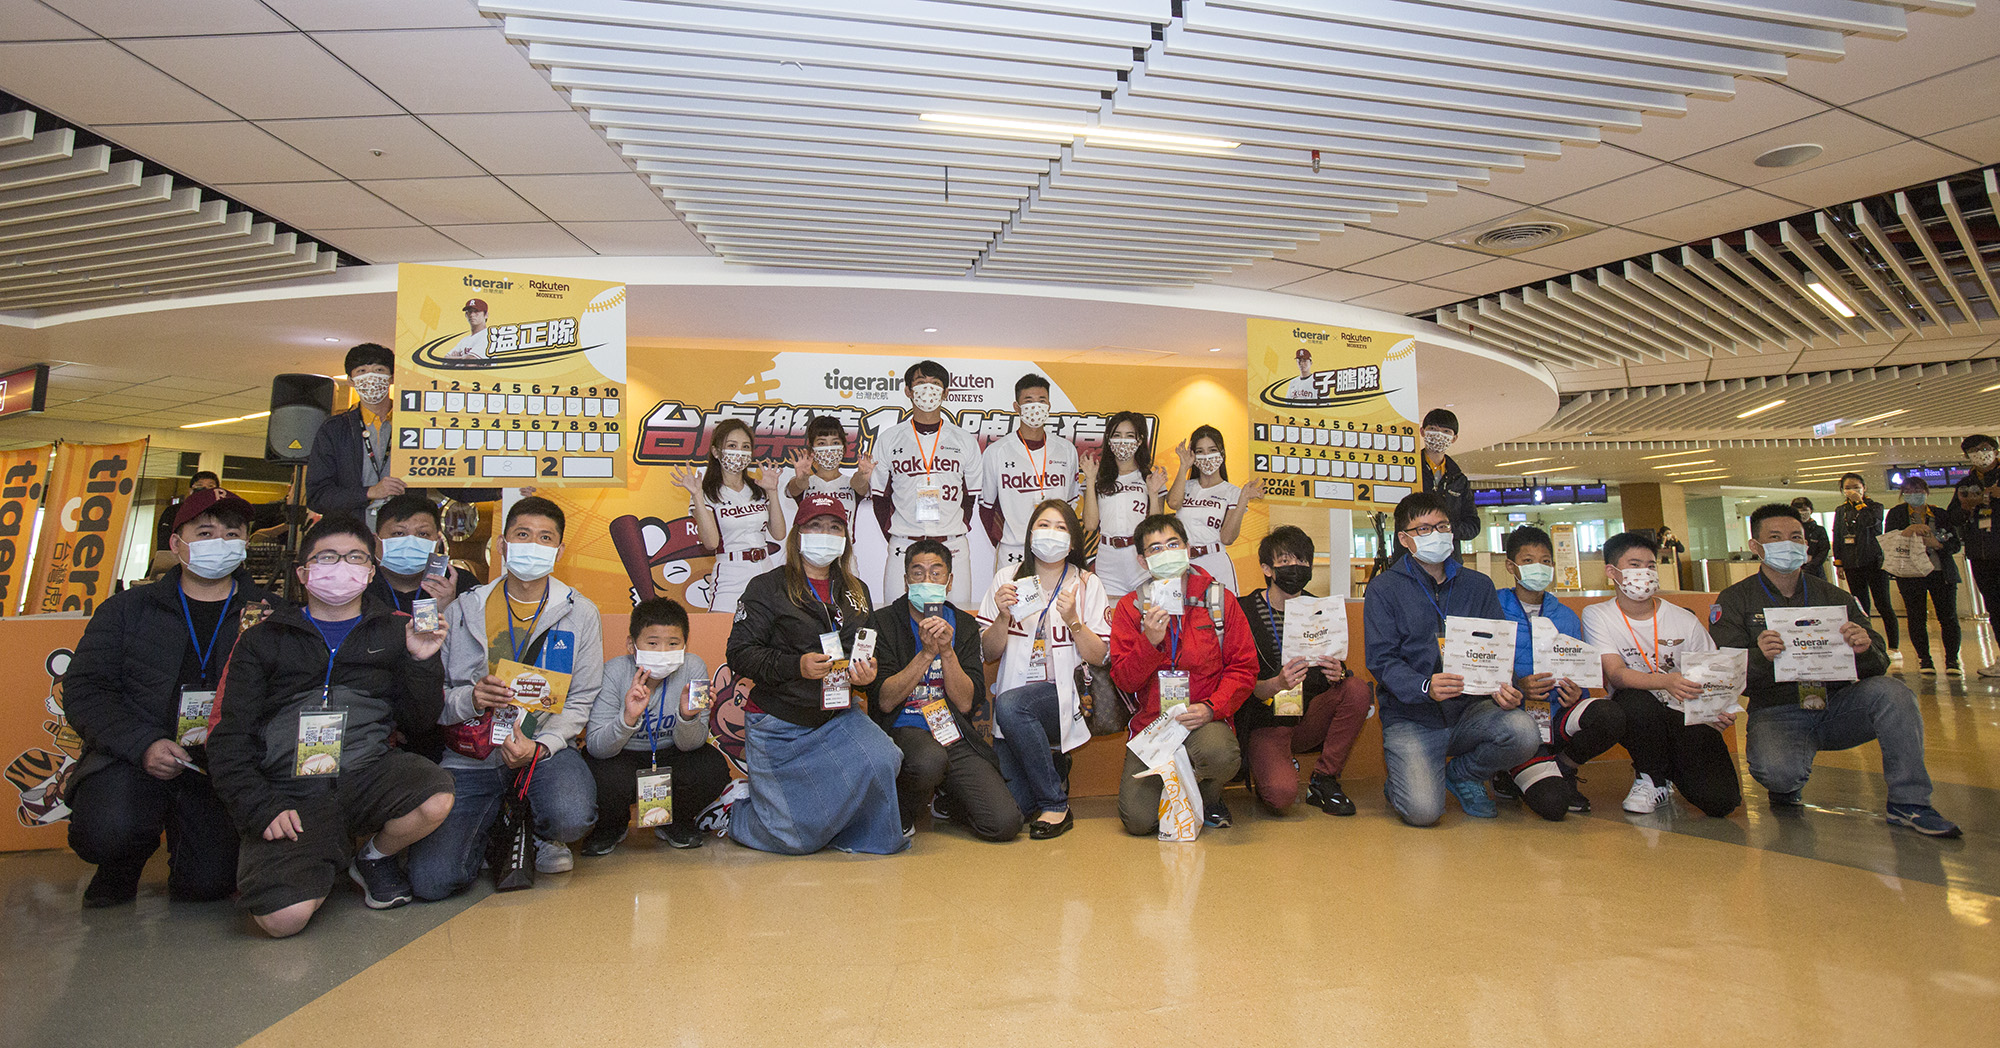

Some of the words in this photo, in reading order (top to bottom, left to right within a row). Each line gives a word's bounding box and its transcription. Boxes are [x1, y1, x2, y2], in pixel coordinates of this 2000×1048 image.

[463, 275, 514, 292] tigerair
[529, 280, 569, 292] Rakuten
[1293, 328, 1330, 343] tigerair
[1341, 333, 1372, 343] Rakuten
[824, 368, 904, 398] tigerair
[948, 373, 994, 391] kuten
[1314, 366, 1378, 394] 子鵬隊
[431, 381, 438, 389] 1
[451, 382, 460, 390] 2
[472, 382, 480, 391] 3
[492, 383, 501, 392] 4
[513, 384, 521, 393] 5
[532, 385, 540, 394] 6
[552, 386, 559, 394] 7
[570, 387, 578, 395] 8
[589, 387, 597, 396] 9
[604, 388, 618, 397] 10
[404, 393, 416, 409] 1
[430, 418, 436, 426] 1
[450, 418, 459, 427] 2
[471, 418, 480, 427] 3
[492, 419, 500, 428] 4
[512, 420, 520, 429] 5
[532, 420, 540, 429] 6
[552, 421, 559, 430] 7
[570, 422, 578, 430] 8
[589, 422, 597, 431] 9
[604, 423, 618, 431] 10
[1402, 427, 1413, 435] 10
[403, 430, 418, 446] 2
[1256, 426, 1265, 439] 1
[410, 457, 456, 466] TOTAL
[464, 456, 475, 476] 1
[542, 458, 558, 476] 2
[892, 456, 960, 477] Rakuten
[1256, 456, 1268, 470] 2
[1404, 456, 1415, 464] 10
[408, 467, 455, 476] SCORE
[1002, 472, 1066, 493] Rakuten
[1892, 472, 1903, 485] 4
[214, 488, 227, 500] R
[942, 484, 958, 502] 32
[1262, 478, 1295, 487] TOTAL
[1301, 480, 1310, 496] 1
[1358, 484, 1370, 500] 2
[1534, 490, 1542, 502] 3
[1132, 500, 1146, 514] 22
[1182, 498, 1221, 510] akuten
[1553, 644, 1582, 656] tigerair
[1793, 637, 1829, 650] tigerair
[1466, 649, 1497, 662] tigerair
